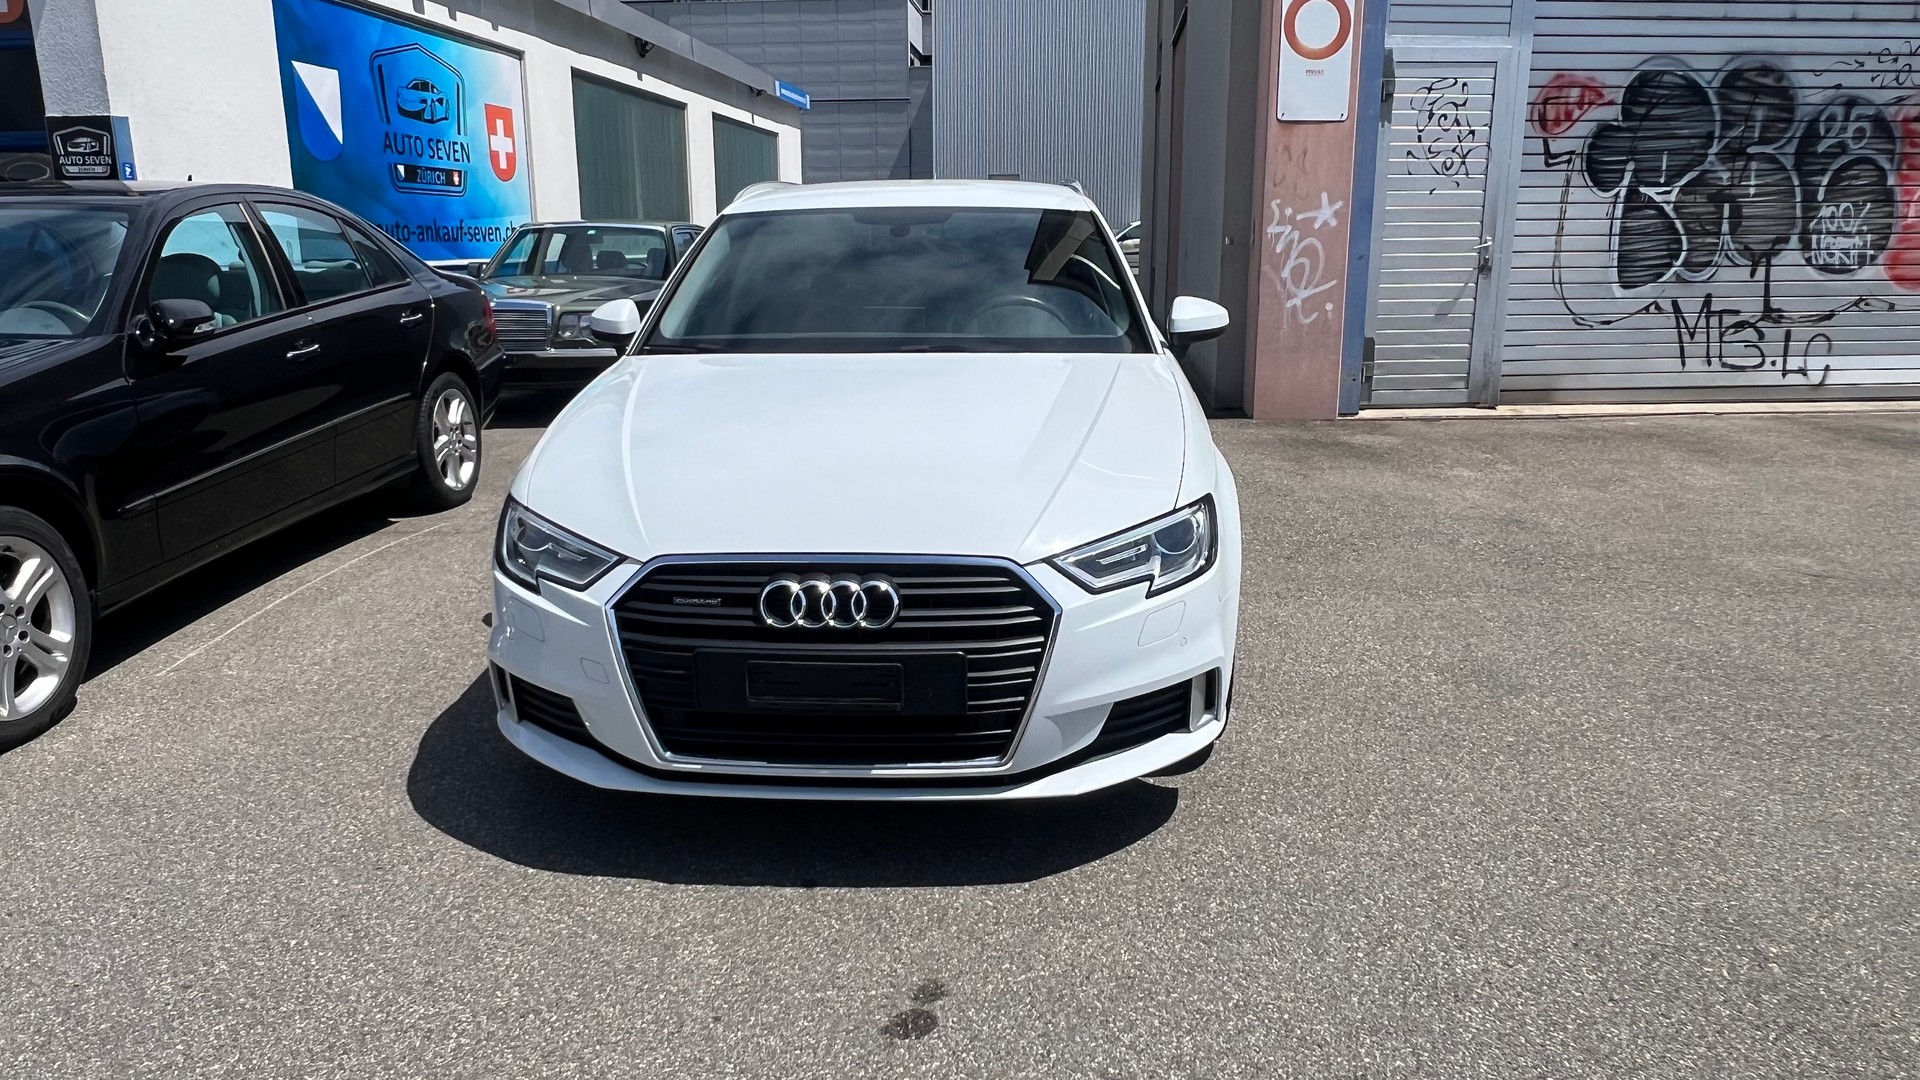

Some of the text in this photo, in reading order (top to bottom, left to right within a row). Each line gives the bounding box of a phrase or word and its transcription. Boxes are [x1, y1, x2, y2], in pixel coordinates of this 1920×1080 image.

[383, 131, 471, 164] AUTO SEVEN
[59, 155, 112, 165] AUTO SEVEN
[416, 167, 447, 184] ZÜRICH
